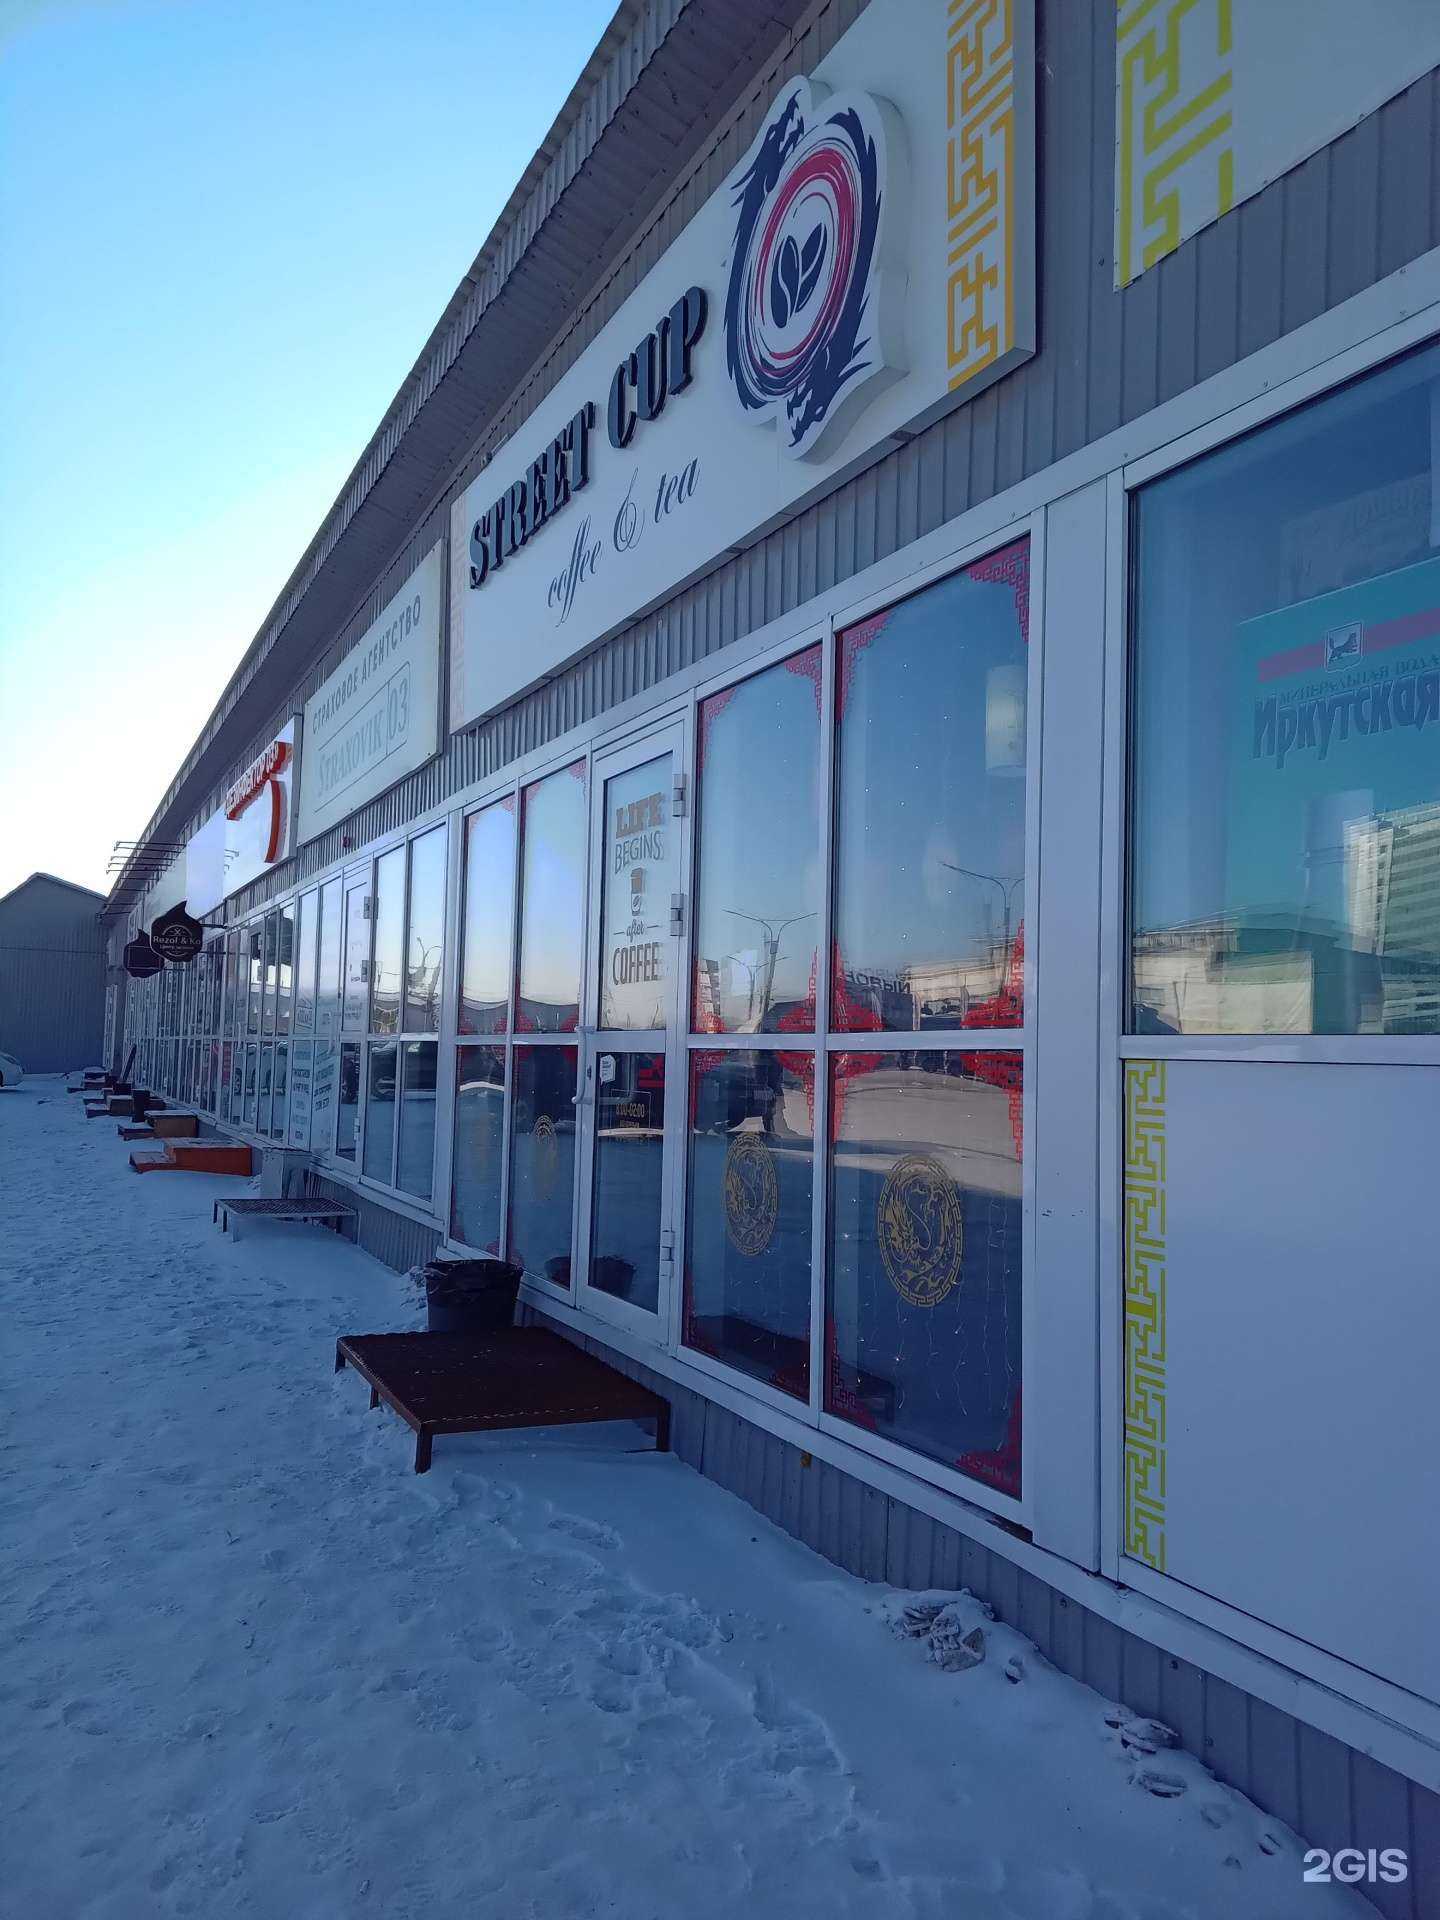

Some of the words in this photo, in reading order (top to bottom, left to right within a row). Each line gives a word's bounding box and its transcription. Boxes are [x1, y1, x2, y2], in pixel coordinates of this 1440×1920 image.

[469, 401, 596, 590] STREET
[607, 285, 708, 449] CUP
[547, 511, 603, 628] coffee
[653, 456, 700, 524] tea
[311, 671, 359, 736] СТРАХОВОЕ
[361, 593, 422, 682] АГЕНТСТВО
[388, 678, 408, 740] 03
[1252, 672, 1440, 769] Иркутская
[614, 830, 664, 875] BEGINS
[612, 941, 661, 986] COFFEE
[626, 918, 645, 943] after
